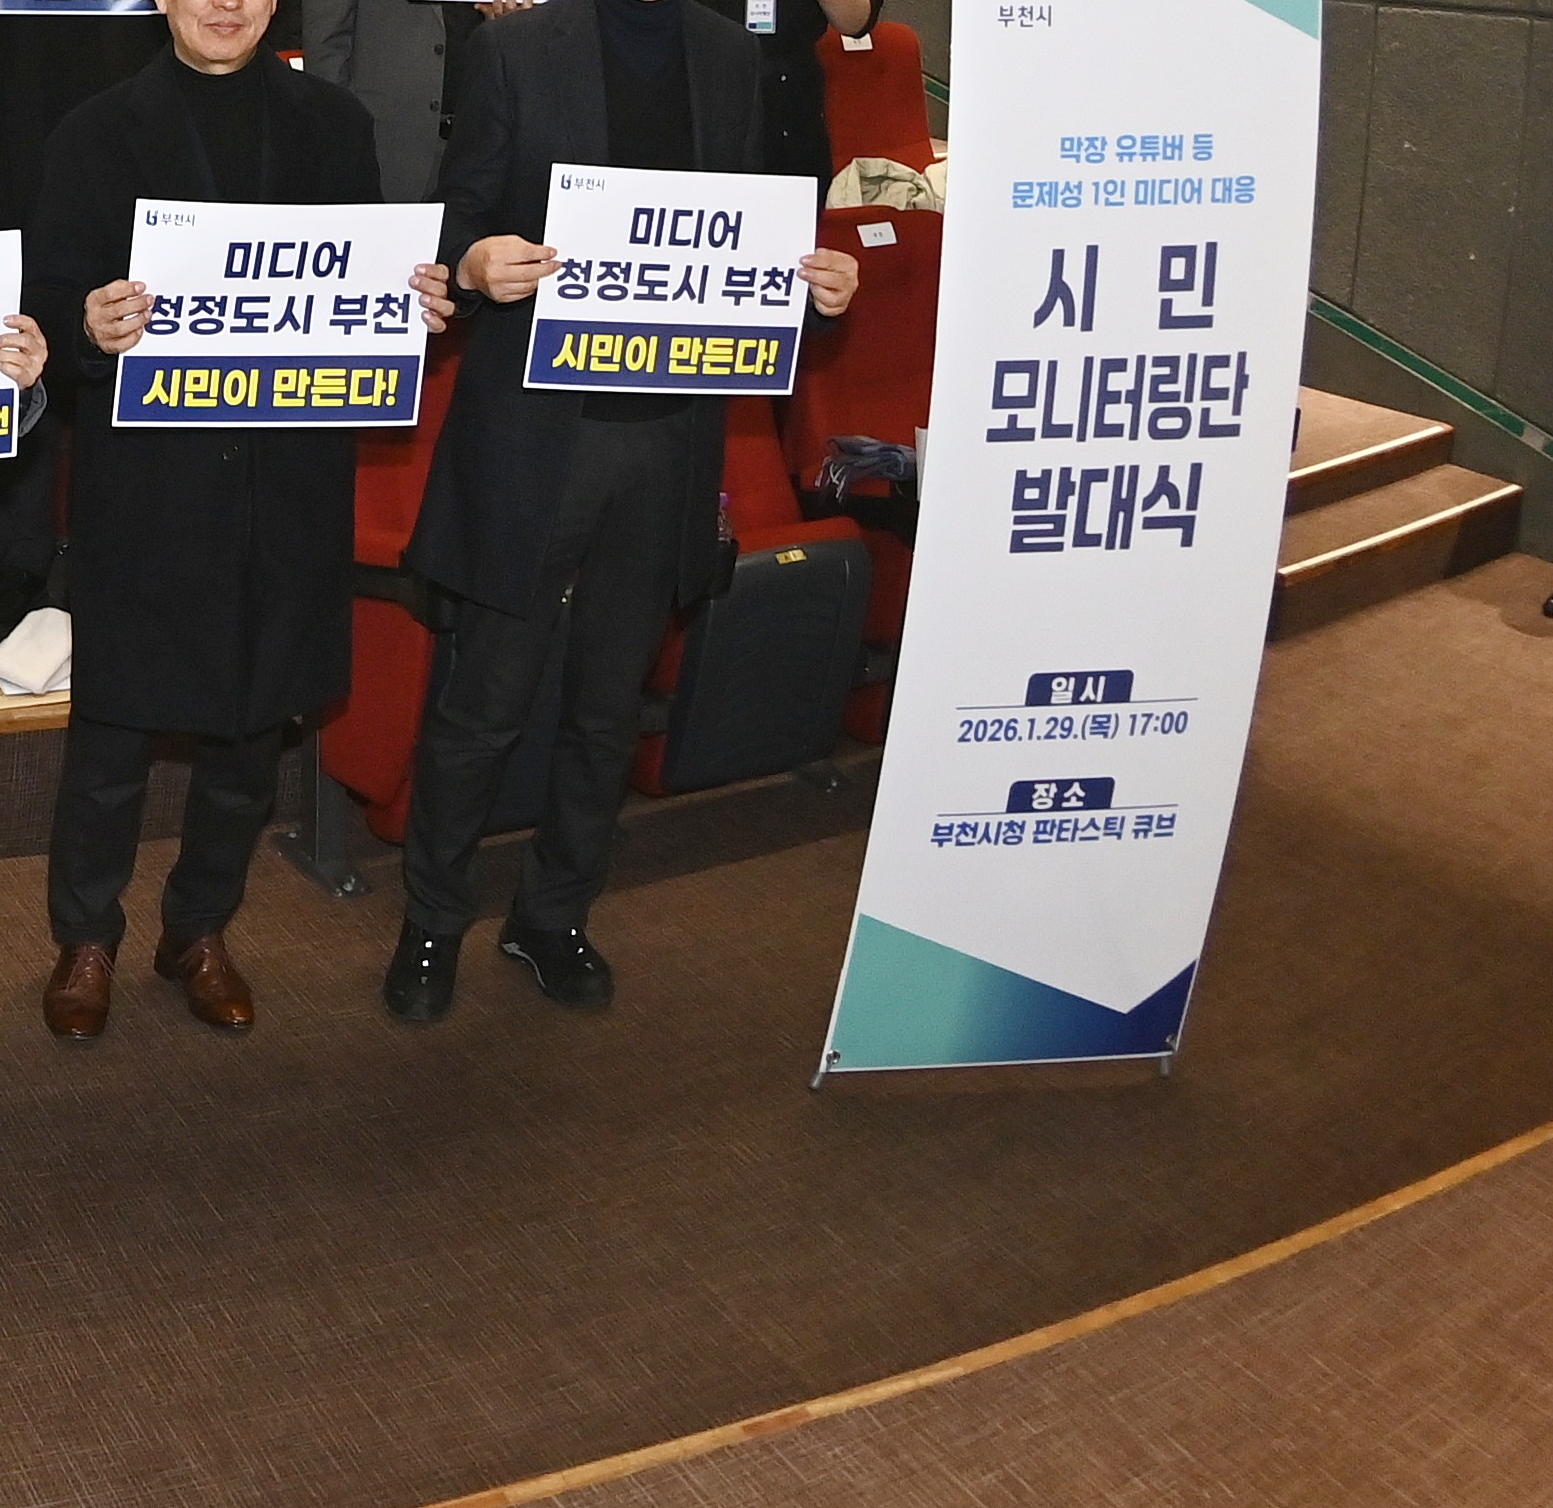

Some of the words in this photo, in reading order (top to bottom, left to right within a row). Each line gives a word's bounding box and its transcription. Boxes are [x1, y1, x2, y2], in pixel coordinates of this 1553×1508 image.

[998, 5, 1051, 27] 부천시
[1061, 137, 1107, 163] 막장
[1116, 135, 1183, 162] 유튜버
[1193, 134, 1213, 161] 등
[575, 178, 605, 191] 부천시
[1012, 181, 1082, 208] 문제성
[1092, 180, 1125, 206] 1인
[1135, 178, 1202, 205] 미디어
[1211, 176, 1255, 203] 대응
[162, 213, 195, 226] 부천시
[629, 208, 742, 250] 미디어
[224, 241, 351, 280] 미디어
[556, 258, 709, 304] 청정도시
[722, 267, 795, 306] 부천
[145, 292, 314, 337] 청정도시
[329, 293, 410, 335] 부천
[553, 334, 658, 372] 시민이
[669, 338, 779, 374] 만든다!
[143, 370, 259, 407] 시민이
[273, 369, 398, 406] 만든다!
[986, 352, 1249, 442] 모니터링단
[1009, 463, 1202, 553] 발대식
[958, 713, 1119, 742] 2026.1.29.(목)
[1130, 711, 1188, 736] 17:00
[931, 820, 1026, 847] 부천시청
[1033, 816, 1125, 843] 판타스틱
[1132, 814, 1176, 839] 큐브
